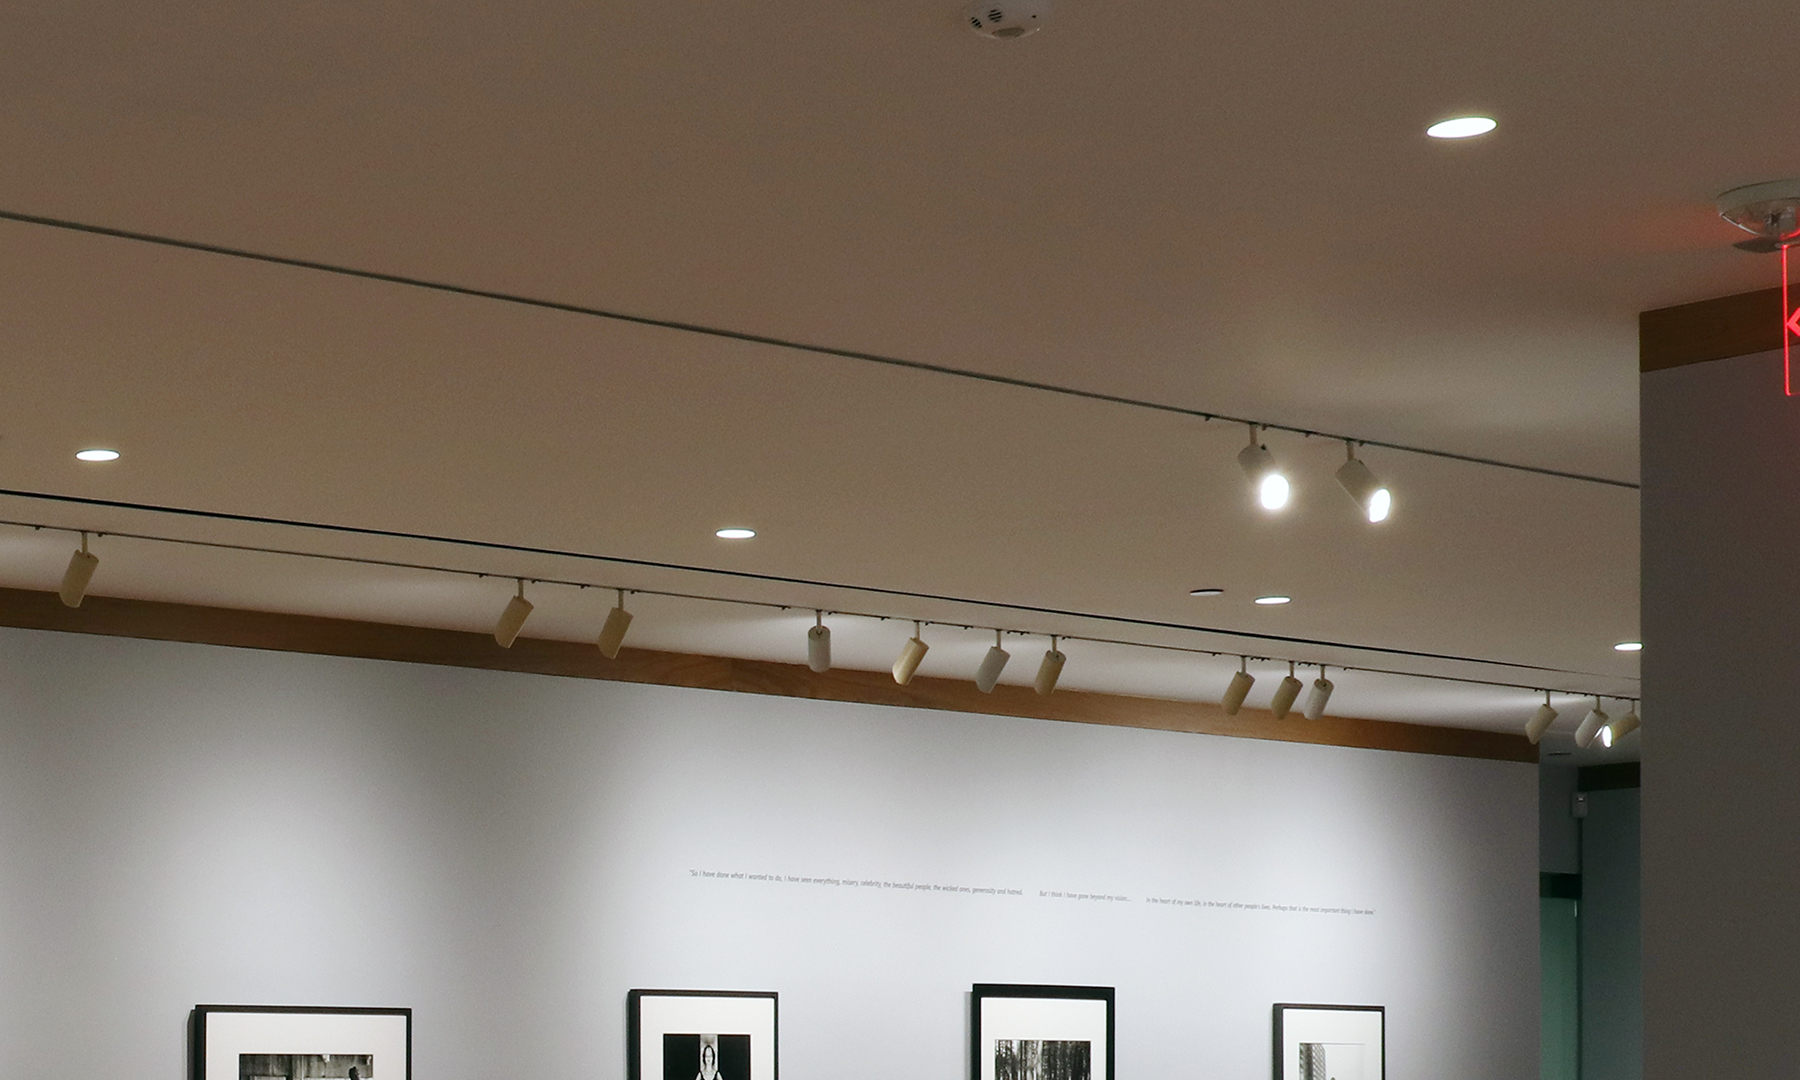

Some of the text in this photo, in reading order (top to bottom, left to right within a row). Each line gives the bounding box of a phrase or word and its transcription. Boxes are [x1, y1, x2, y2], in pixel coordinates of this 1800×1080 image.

[703, 870, 715, 878] have
[749, 873, 768, 881] wanted
[788, 875, 800, 883] have
[892, 881, 914, 890] beautiful
[942, 884, 959, 892] wicked
[972, 887, 996, 895] generosity
[996, 887, 1006, 895] and
[1051, 890, 1062, 898] think
[1090, 893, 1106, 901] beyond
